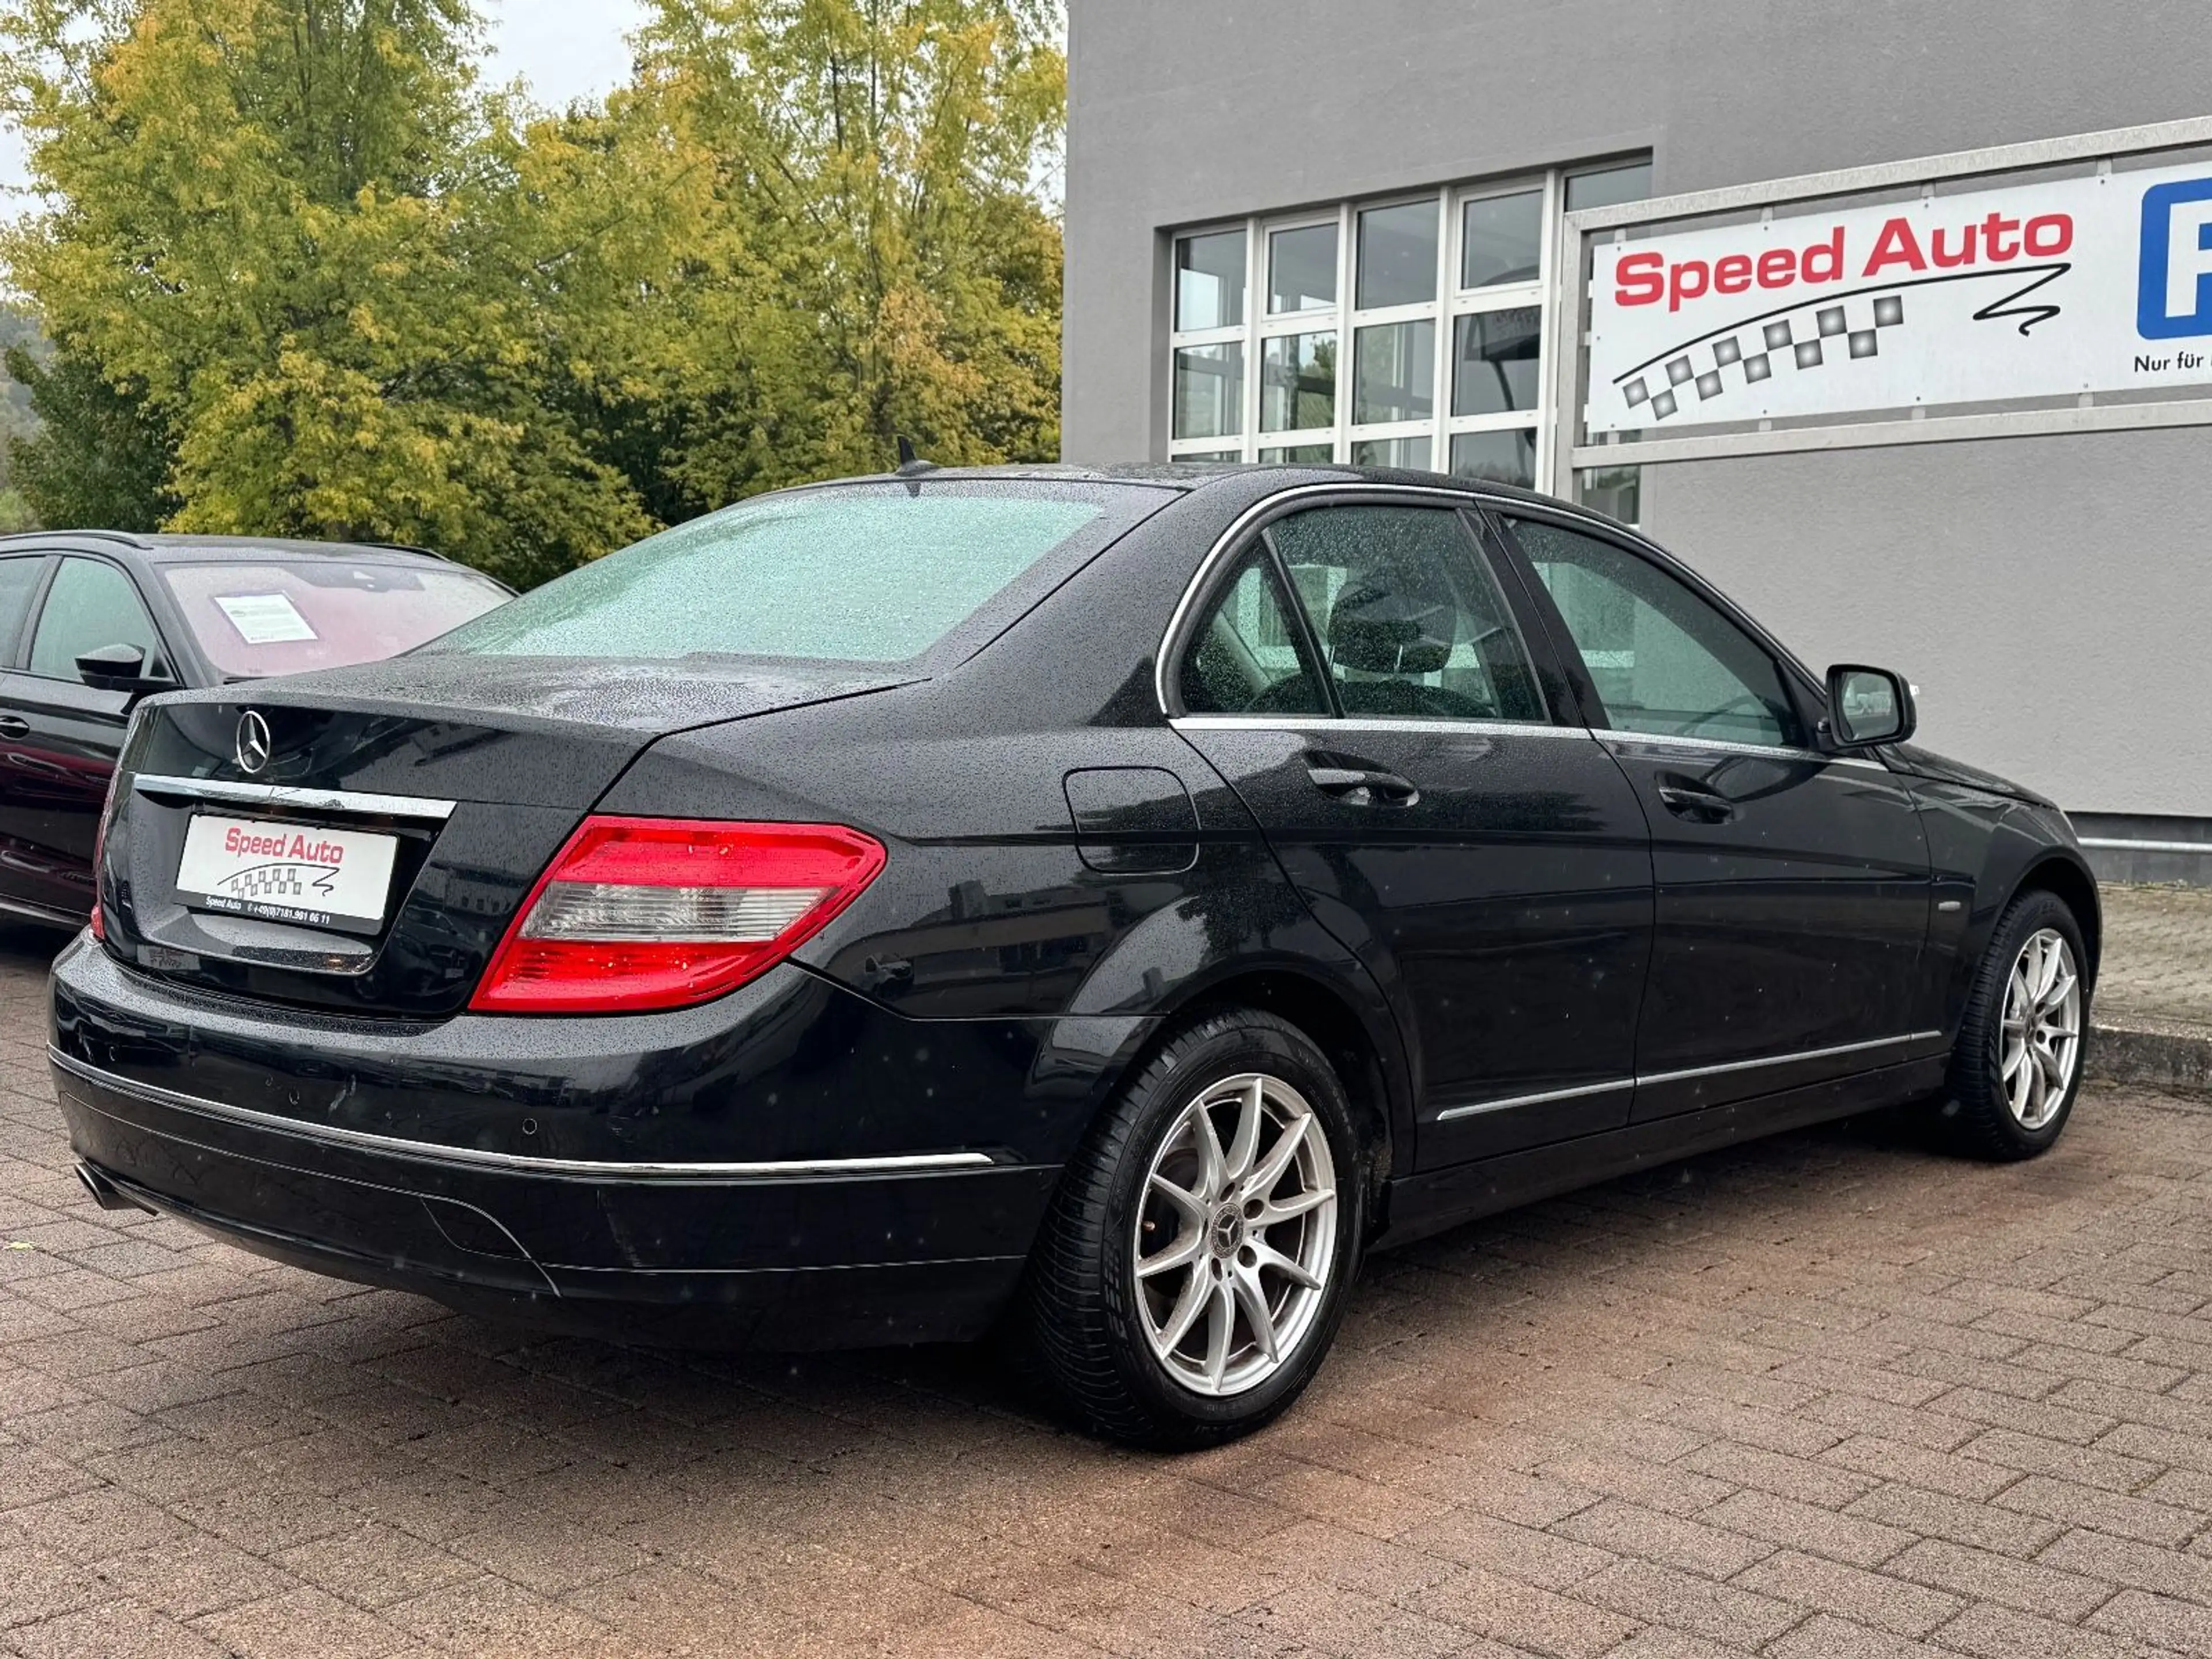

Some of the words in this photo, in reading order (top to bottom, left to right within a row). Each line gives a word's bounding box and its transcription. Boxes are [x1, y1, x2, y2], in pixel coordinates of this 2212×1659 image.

[1615, 226, 1844, 312] Speed
[1862, 213, 2074, 277] Auto
[2134, 355, 2171, 373] Nur
[2177, 351, 2205, 369] für
[225, 827, 287, 858] Speed
[288, 835, 344, 864] Auto
[206, 896, 226, 908] Speed
[226, 899, 241, 910] Auto
